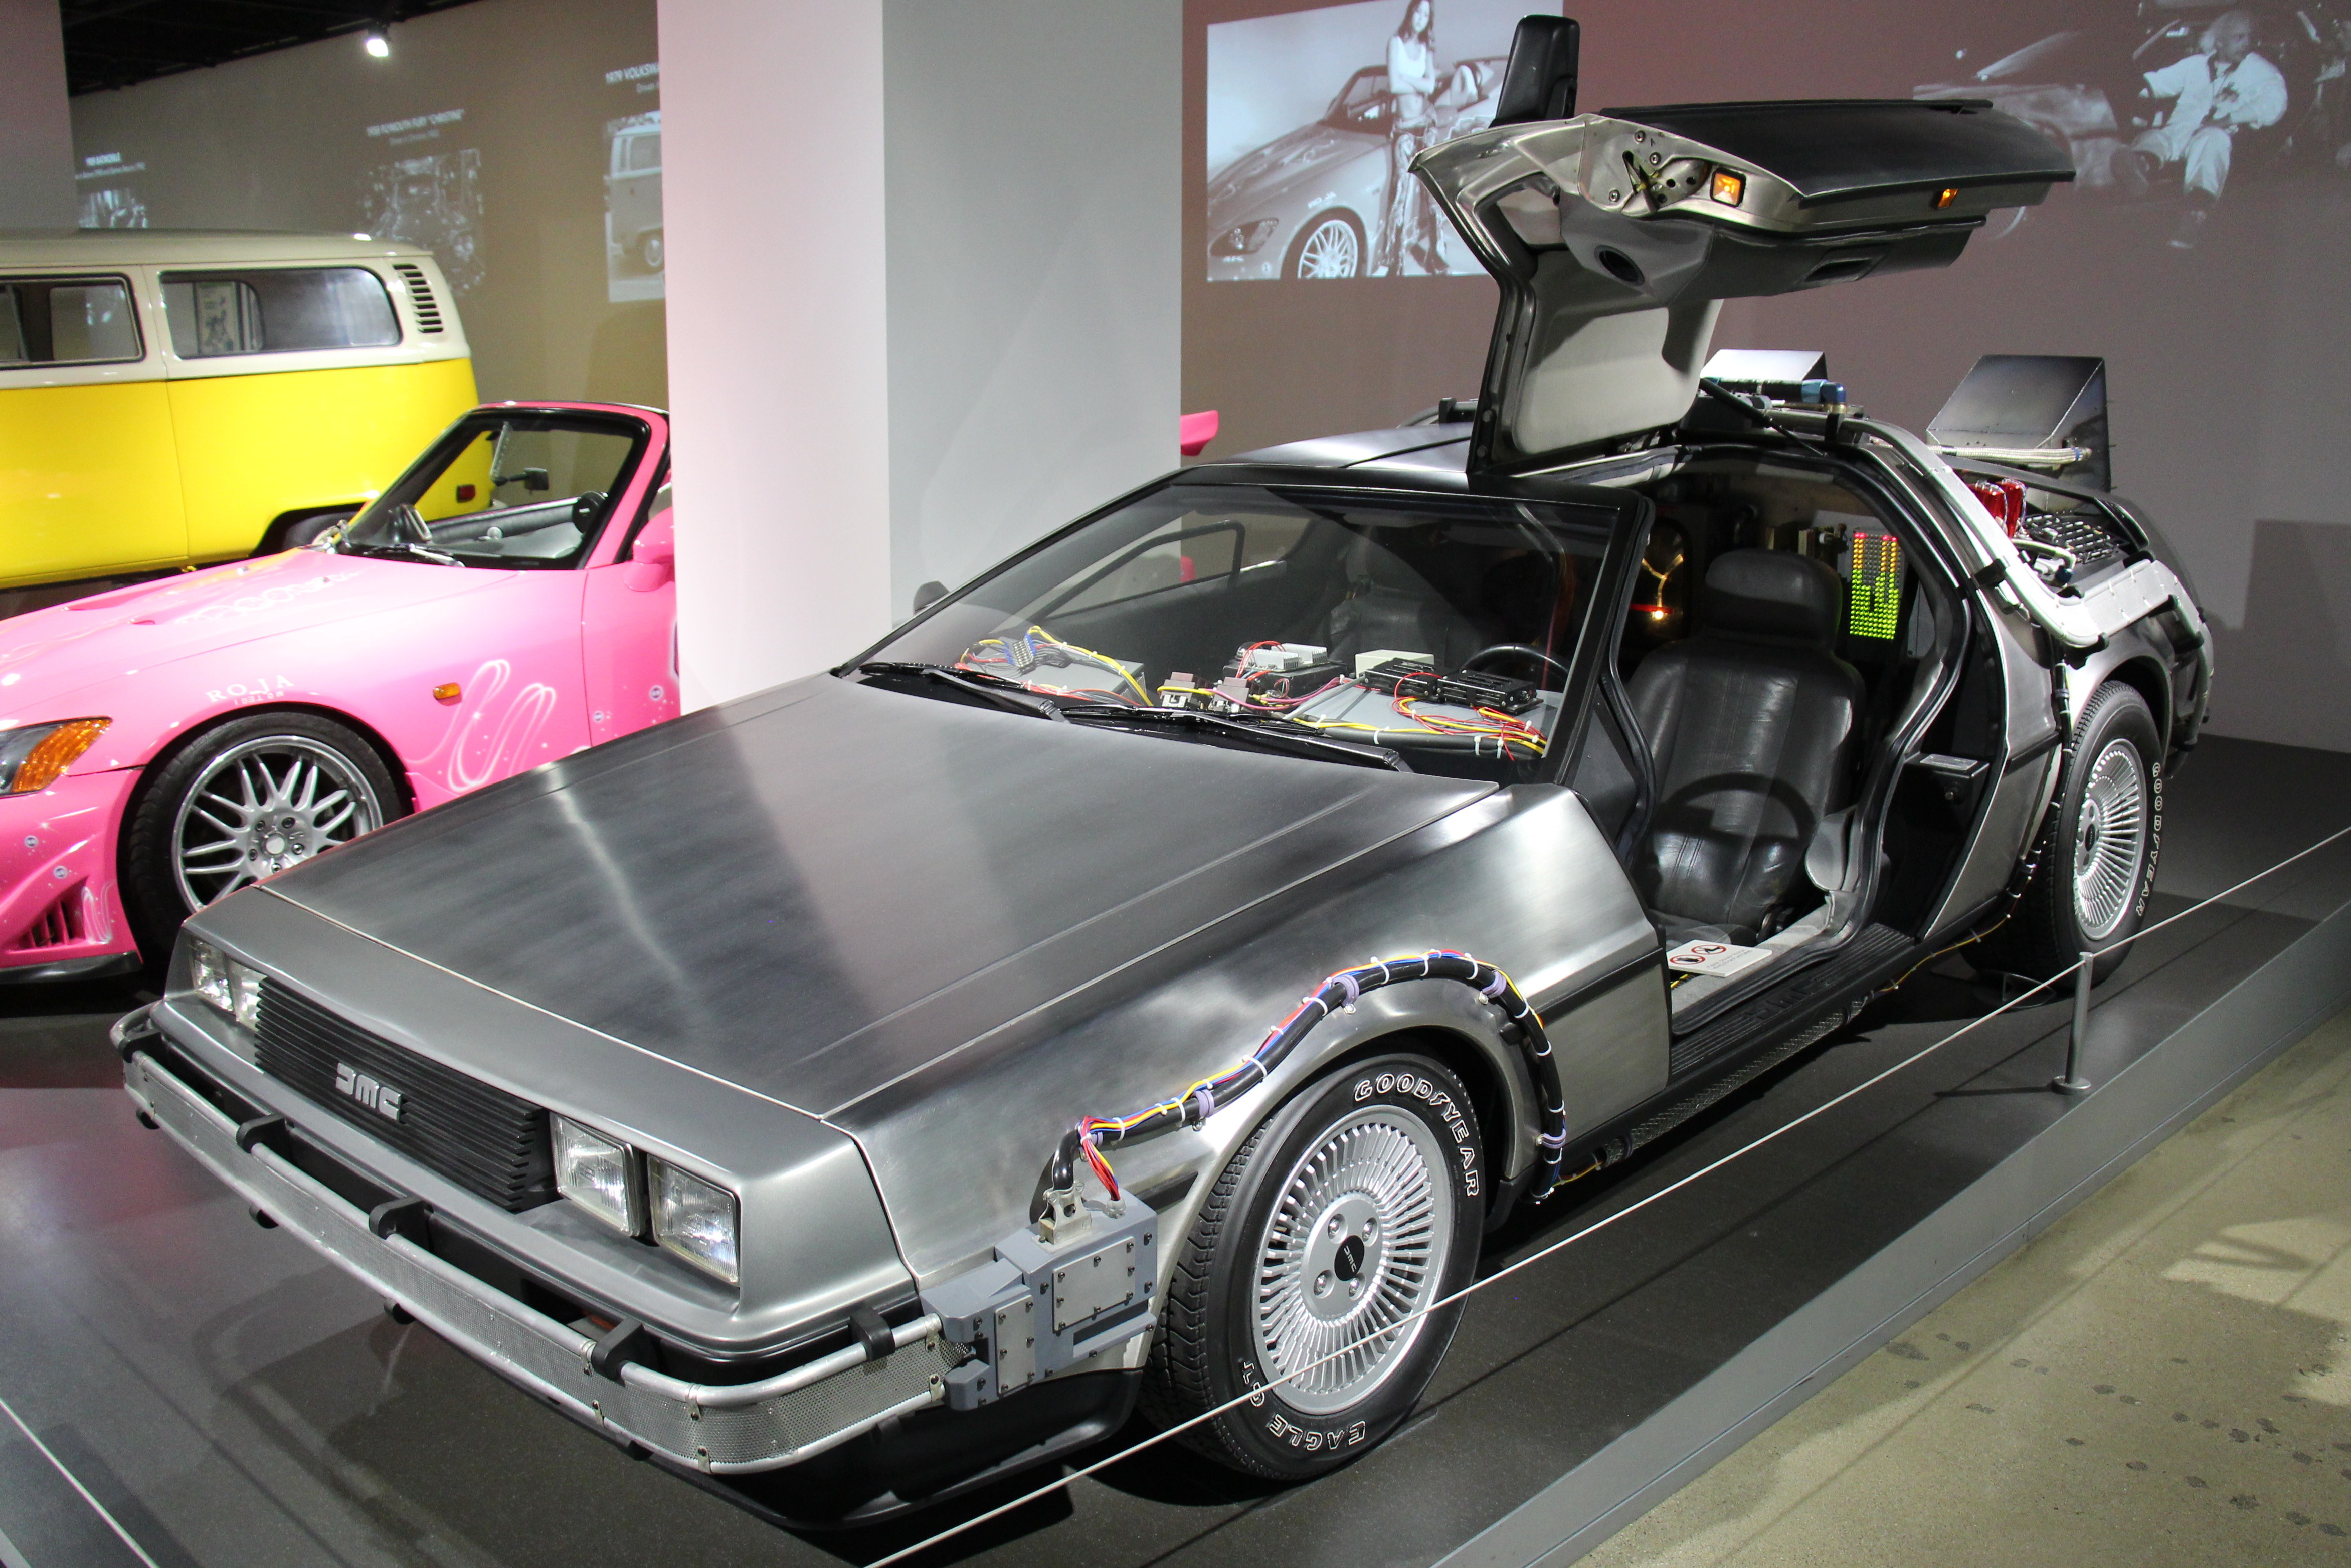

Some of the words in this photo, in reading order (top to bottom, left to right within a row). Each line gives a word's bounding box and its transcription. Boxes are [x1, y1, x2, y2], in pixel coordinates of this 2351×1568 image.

[2136, 762, 2162, 916] GOODYEAR
[335, 1062, 401, 1121] DMC
[1355, 1073, 1479, 1197] GOODYEAR
[1344, 1245, 1357, 1273] DMC
[1269, 1413, 1365, 1451] EAGLE
